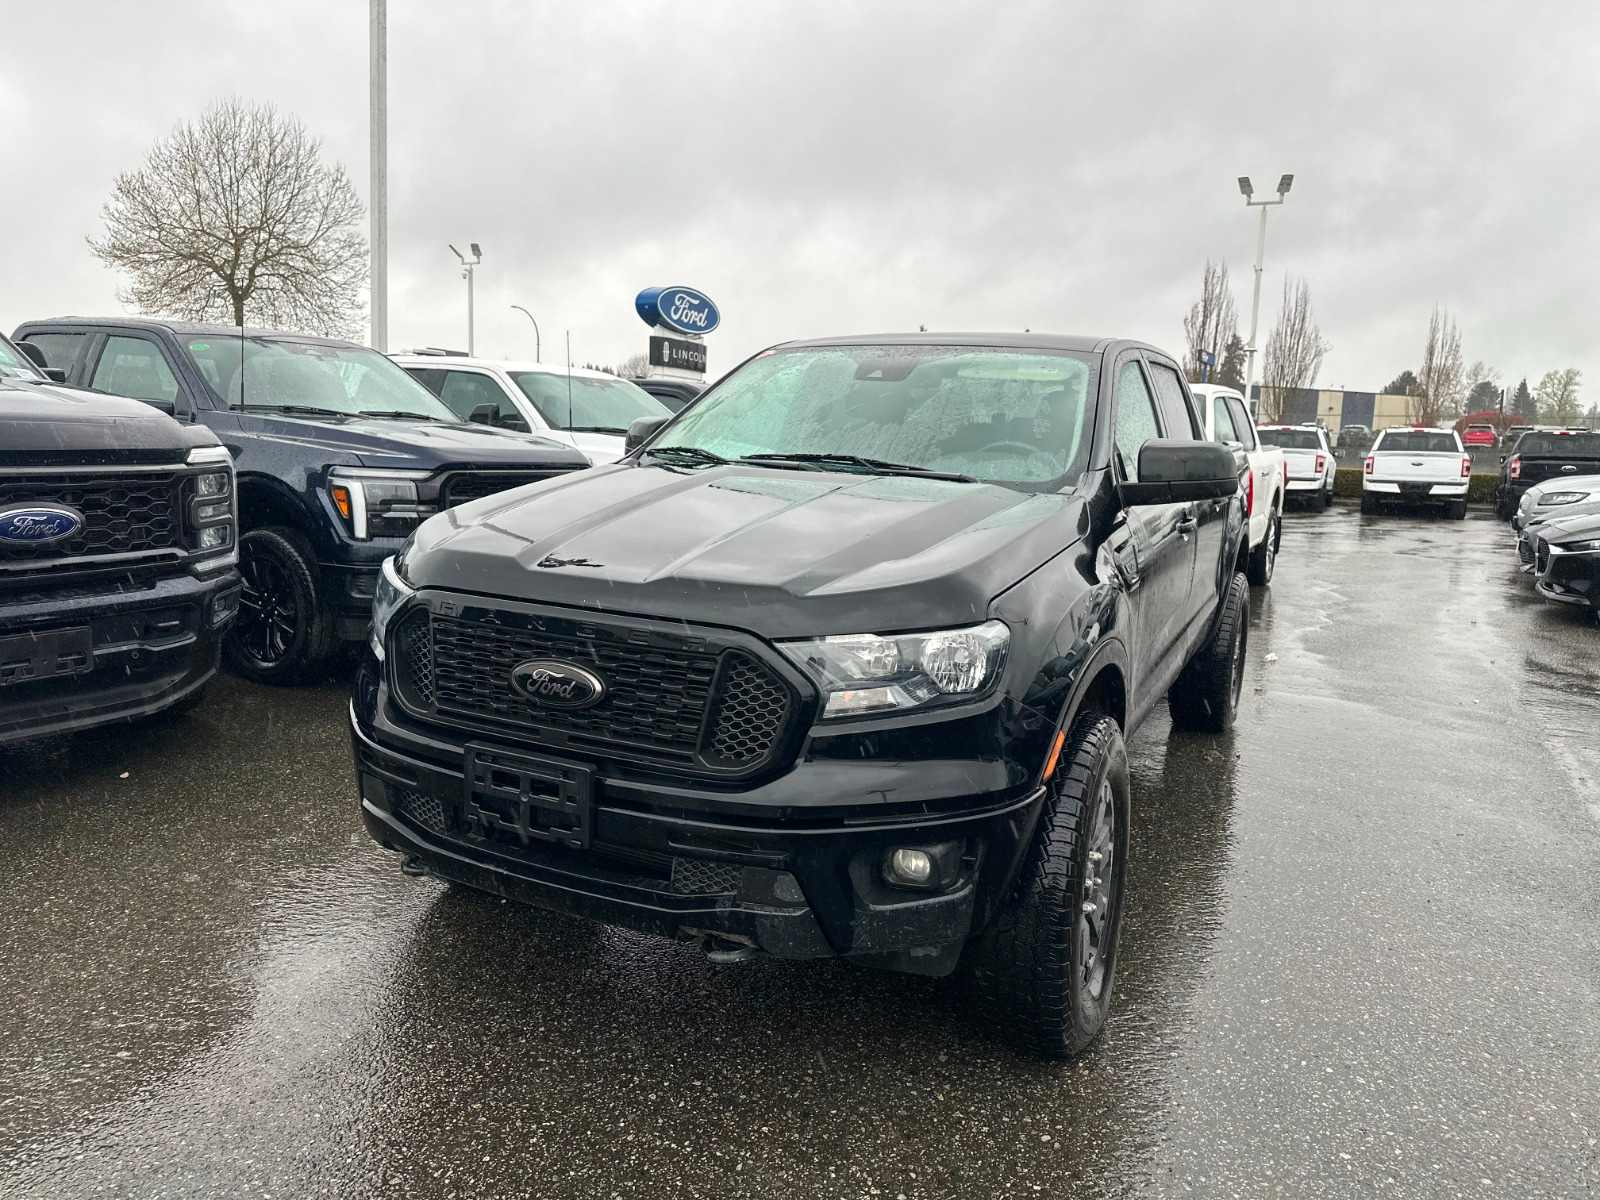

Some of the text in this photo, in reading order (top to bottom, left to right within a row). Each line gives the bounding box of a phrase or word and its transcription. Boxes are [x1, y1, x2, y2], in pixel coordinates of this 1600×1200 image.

[671, 293, 708, 327] Ford
[8, 515, 60, 536] Ford
[526, 668, 577, 698] Ford
